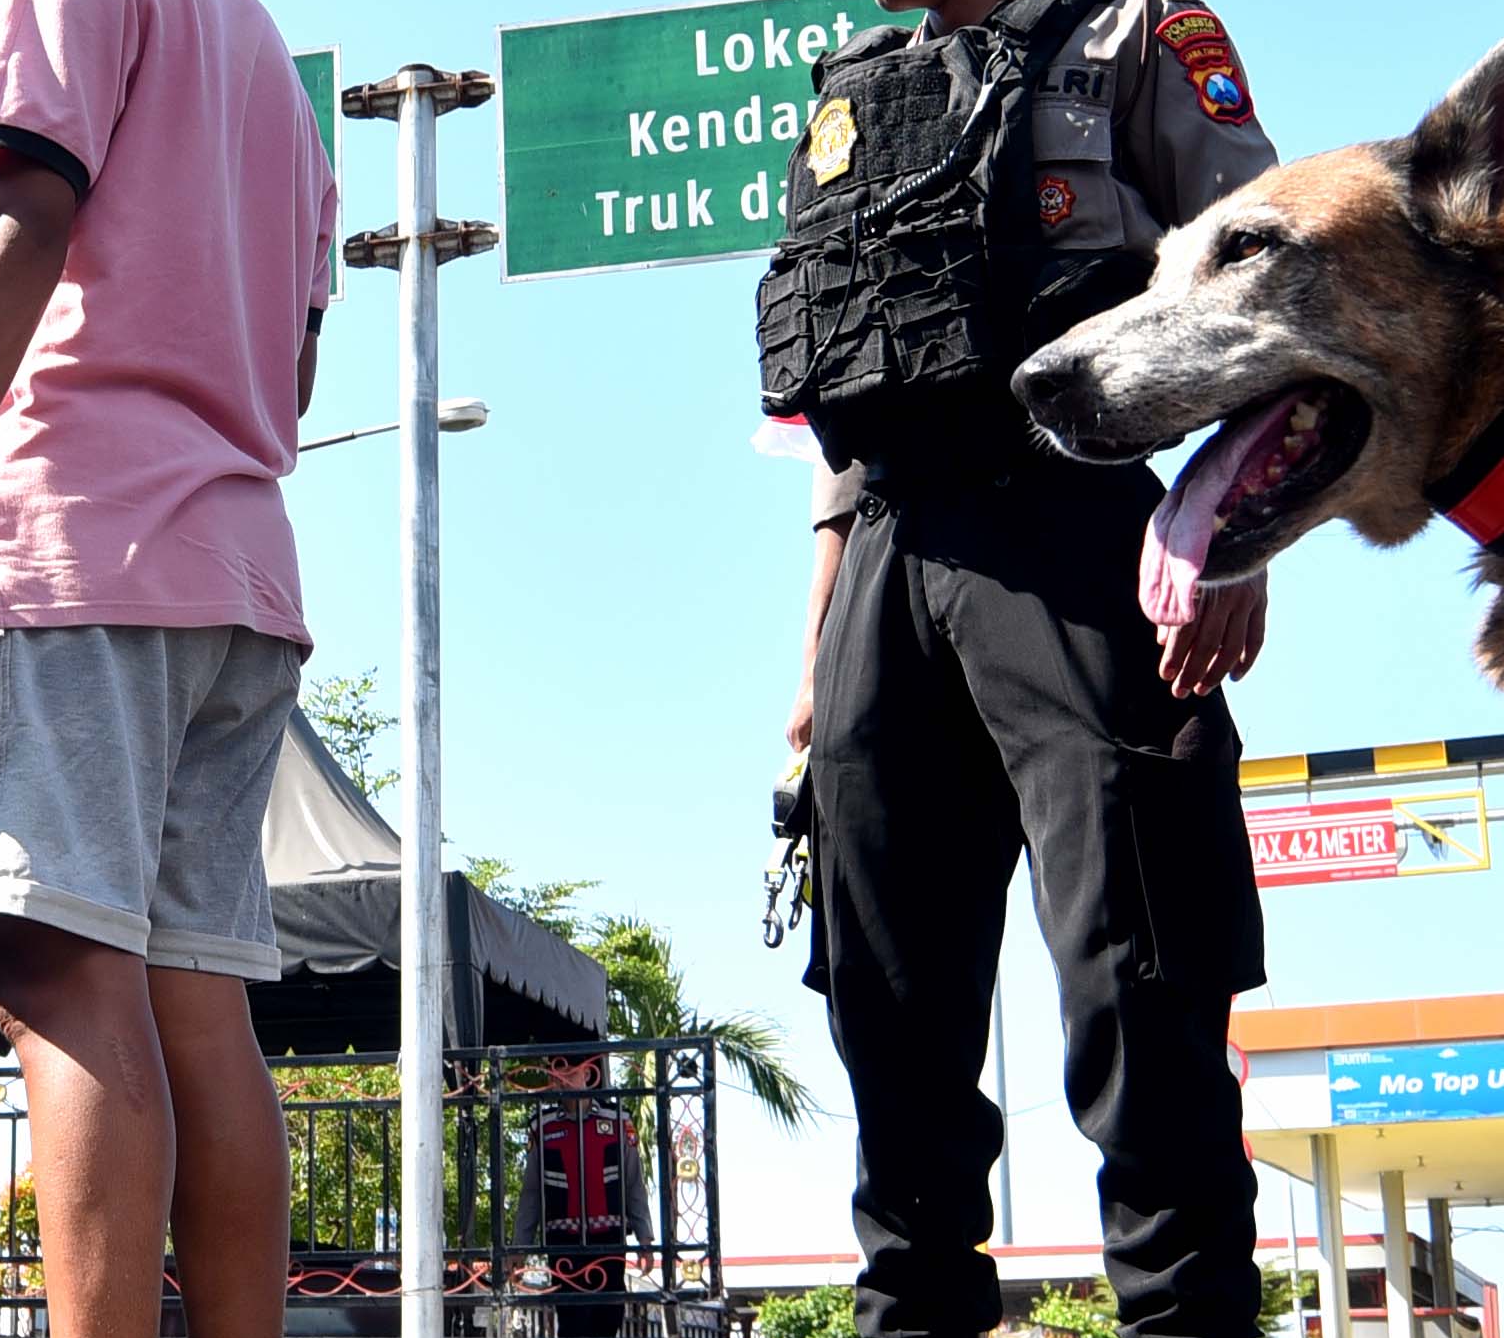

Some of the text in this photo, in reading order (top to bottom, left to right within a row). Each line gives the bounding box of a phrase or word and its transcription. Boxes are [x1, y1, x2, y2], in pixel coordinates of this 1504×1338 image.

[694, 12, 854, 77] Loket
[1037, 68, 1105, 98] LRI
[595, 179, 714, 236] Truk
[1288, 830, 1319, 862] 4,2
[1321, 824, 1387, 857] METER
[1379, 1074, 1424, 1096] Mo
[1431, 1071, 1479, 1096] Top
